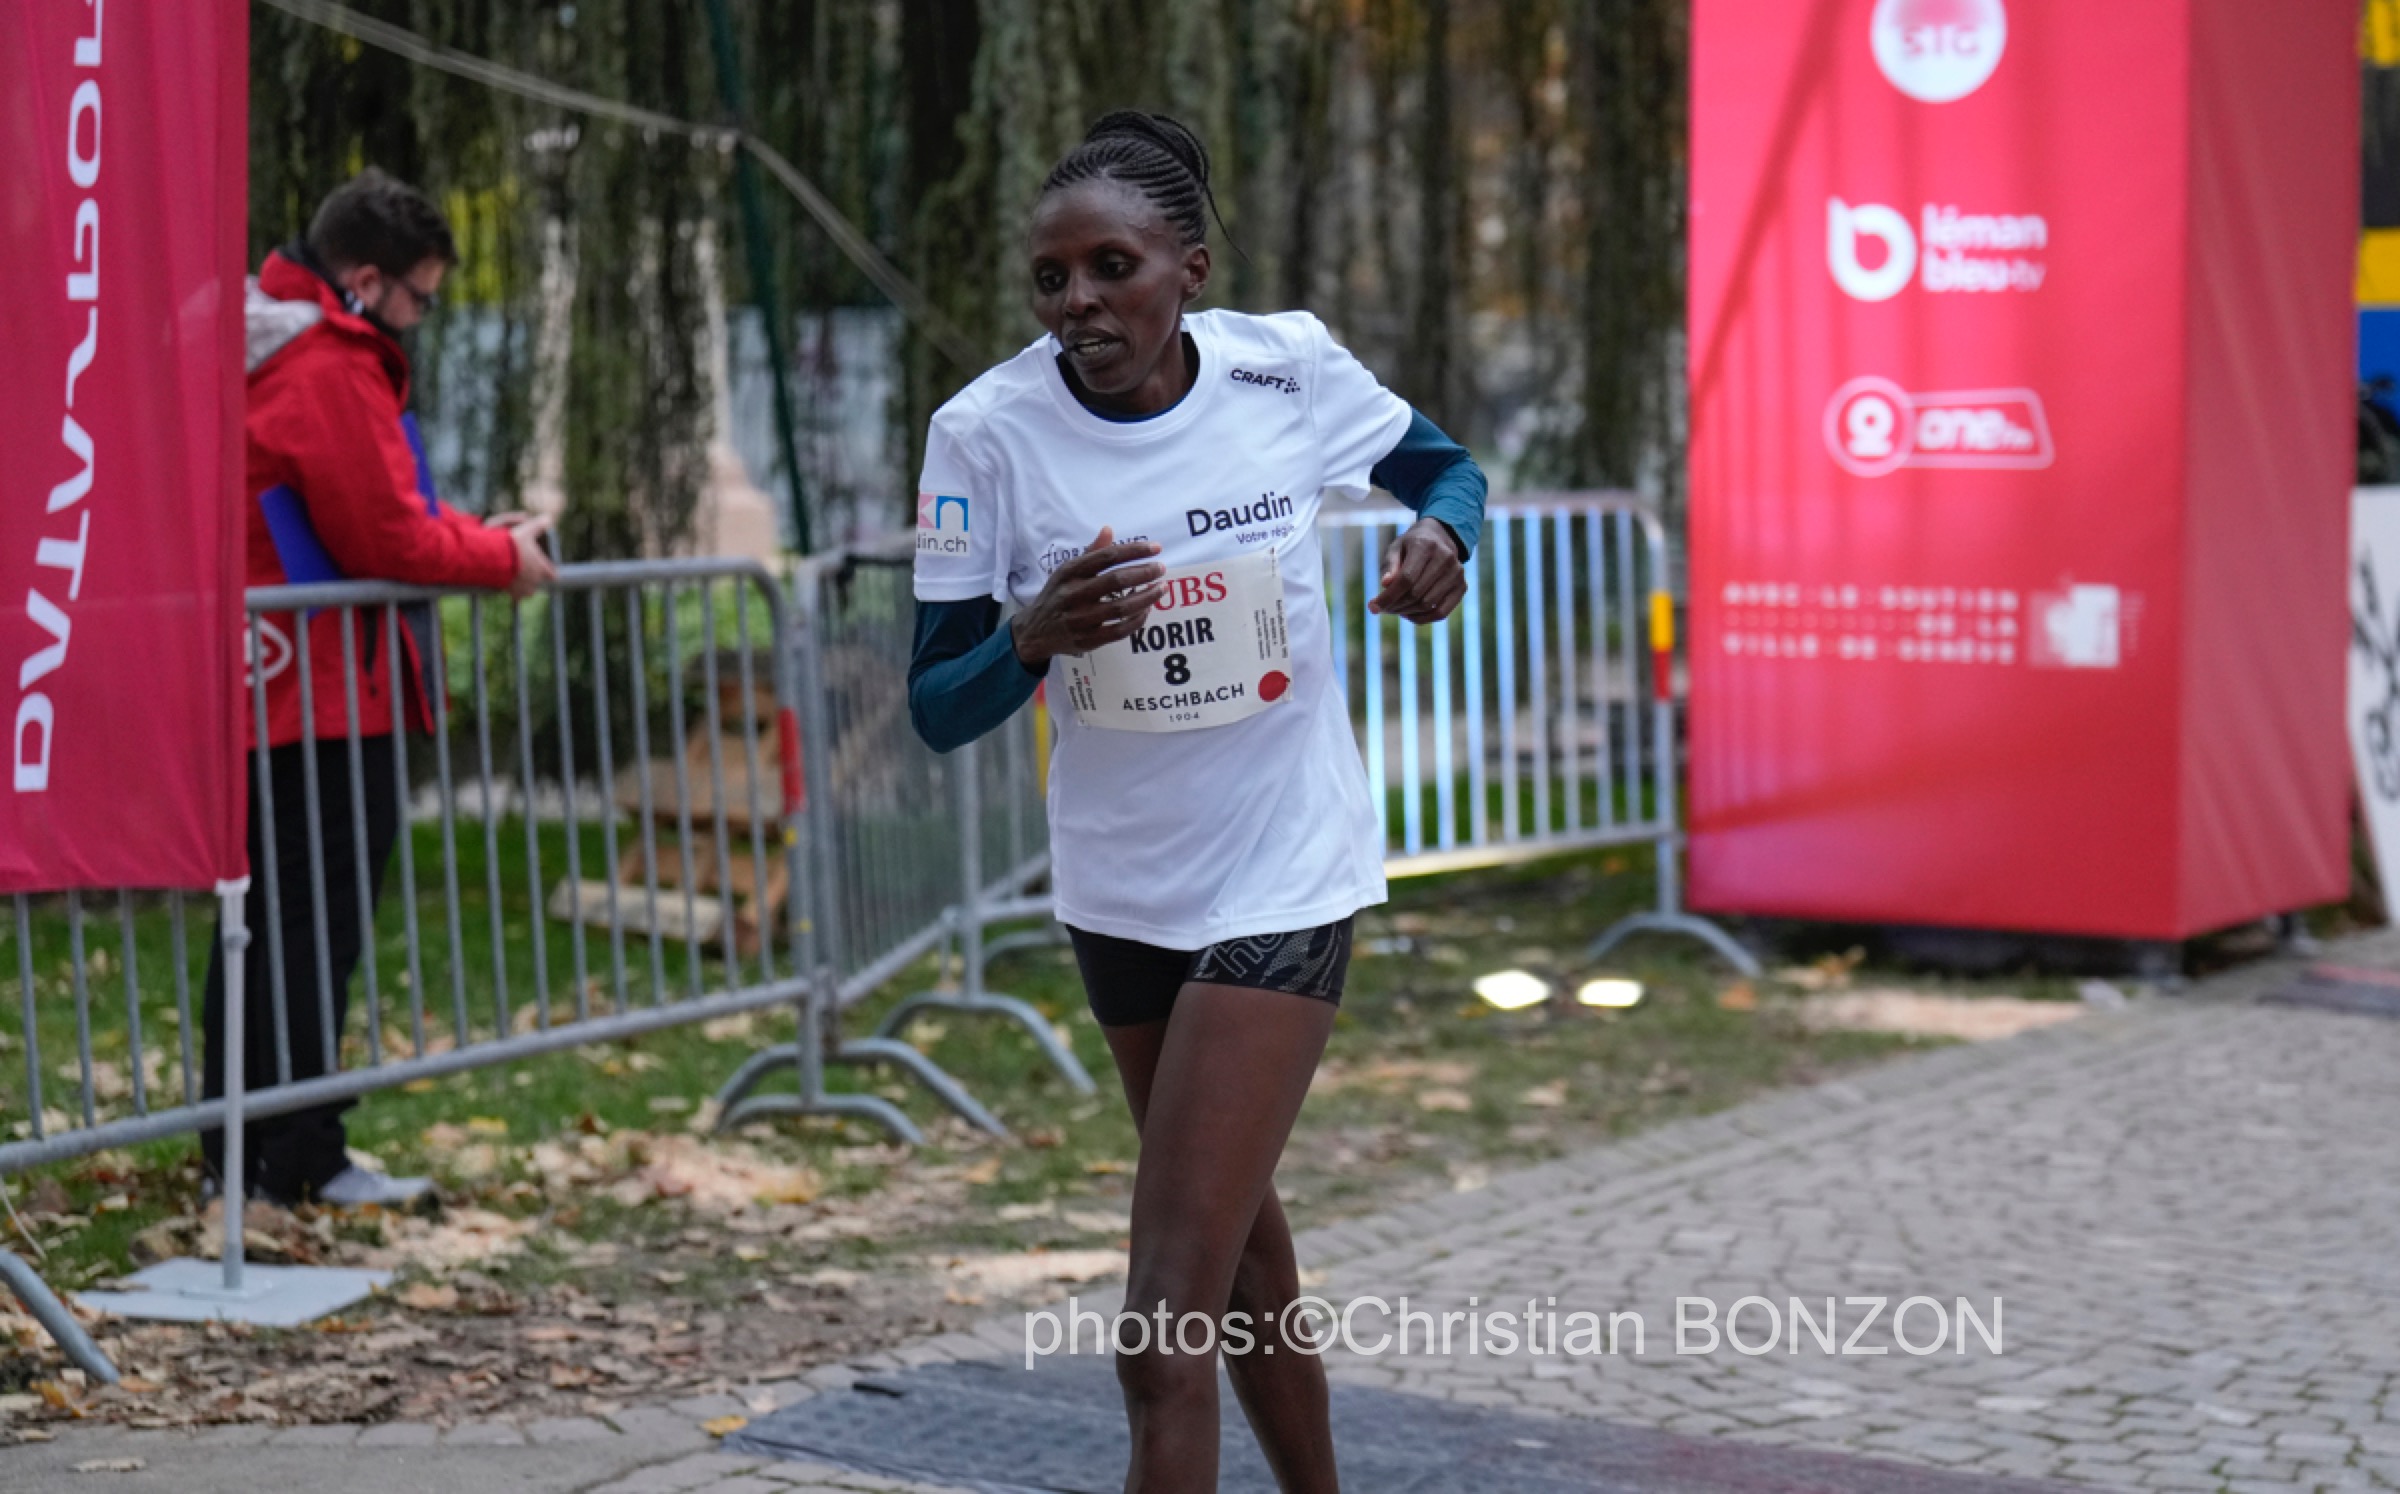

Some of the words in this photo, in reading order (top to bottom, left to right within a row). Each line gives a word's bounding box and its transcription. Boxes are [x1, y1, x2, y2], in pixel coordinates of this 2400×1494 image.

[1230, 368, 1287, 390] CRAFT
[1185, 490, 1294, 538] Daudin
[1129, 616, 1215, 655] KORIR
[1163, 652, 1191, 686] 8
[1122, 681, 1245, 712] AESCHBACH
[1168, 711, 1201, 723] 1904
